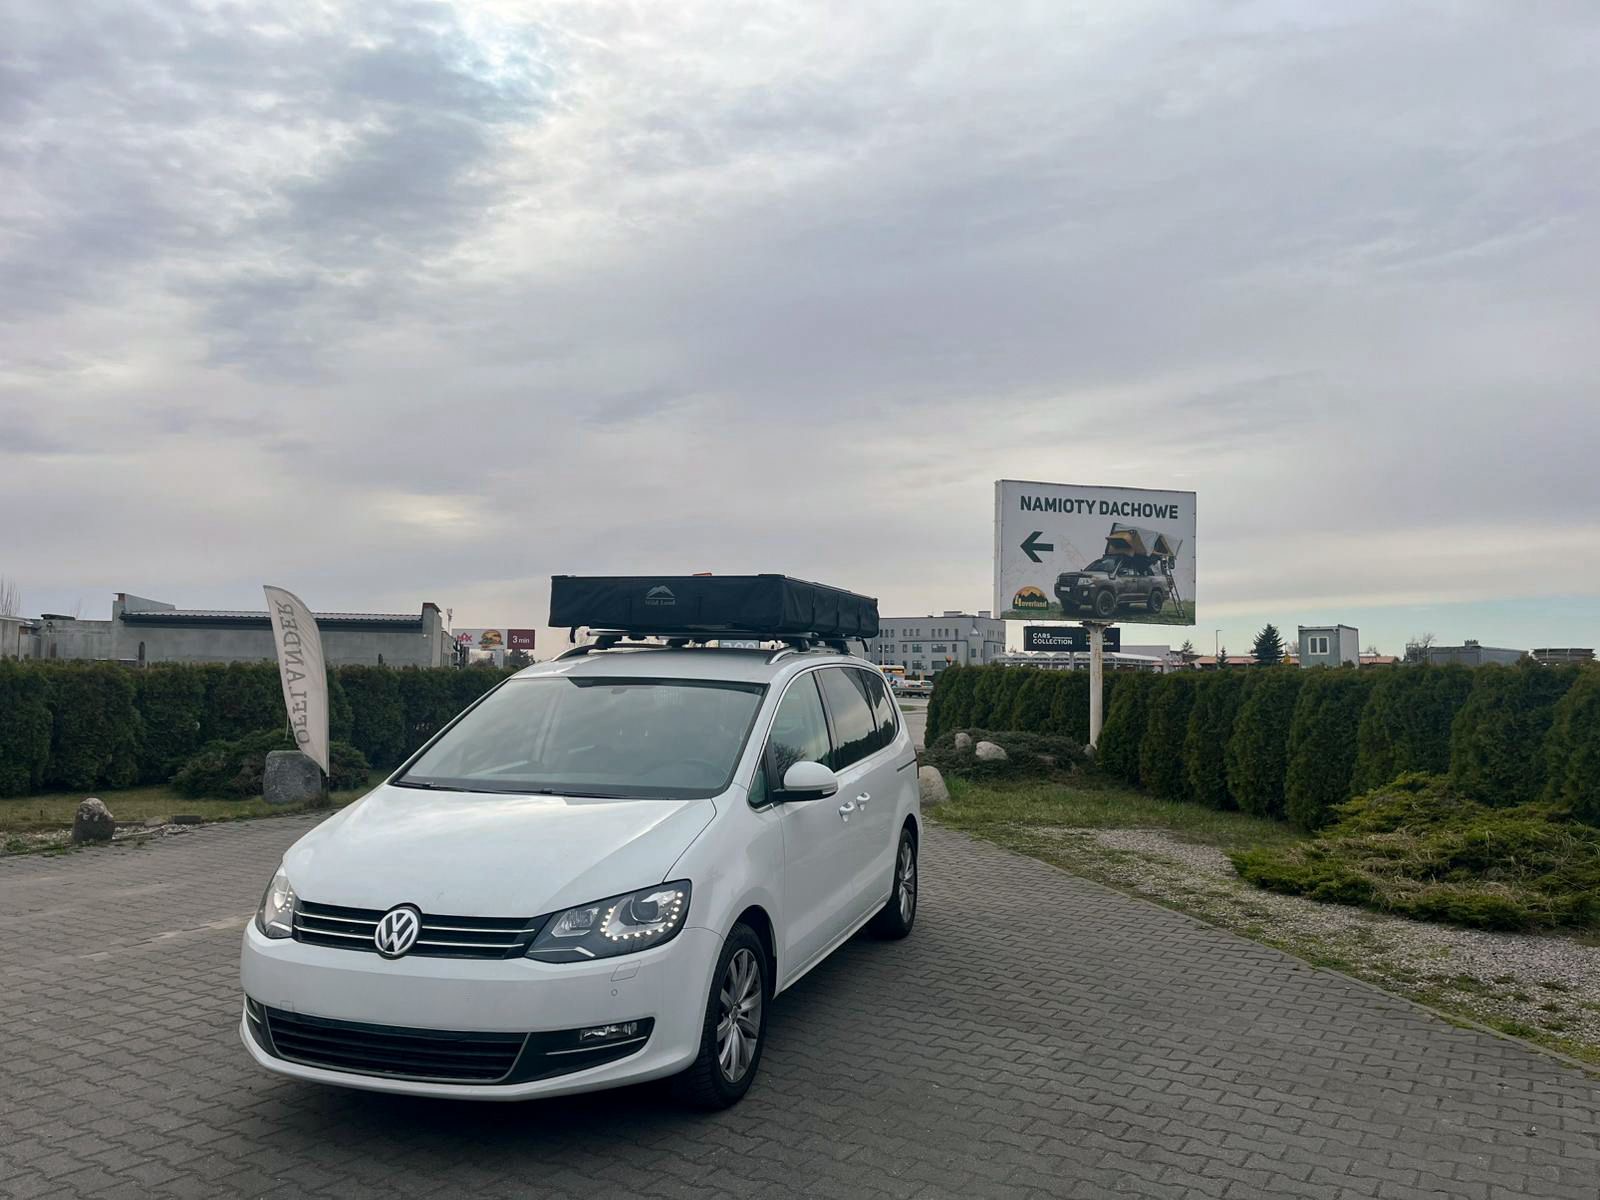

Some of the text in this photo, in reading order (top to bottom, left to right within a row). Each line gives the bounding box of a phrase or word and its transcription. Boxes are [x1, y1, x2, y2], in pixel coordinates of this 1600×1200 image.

[1020, 495, 1179, 519] NAMIOTY DACHOWE
[512, 635, 518, 644] 3
